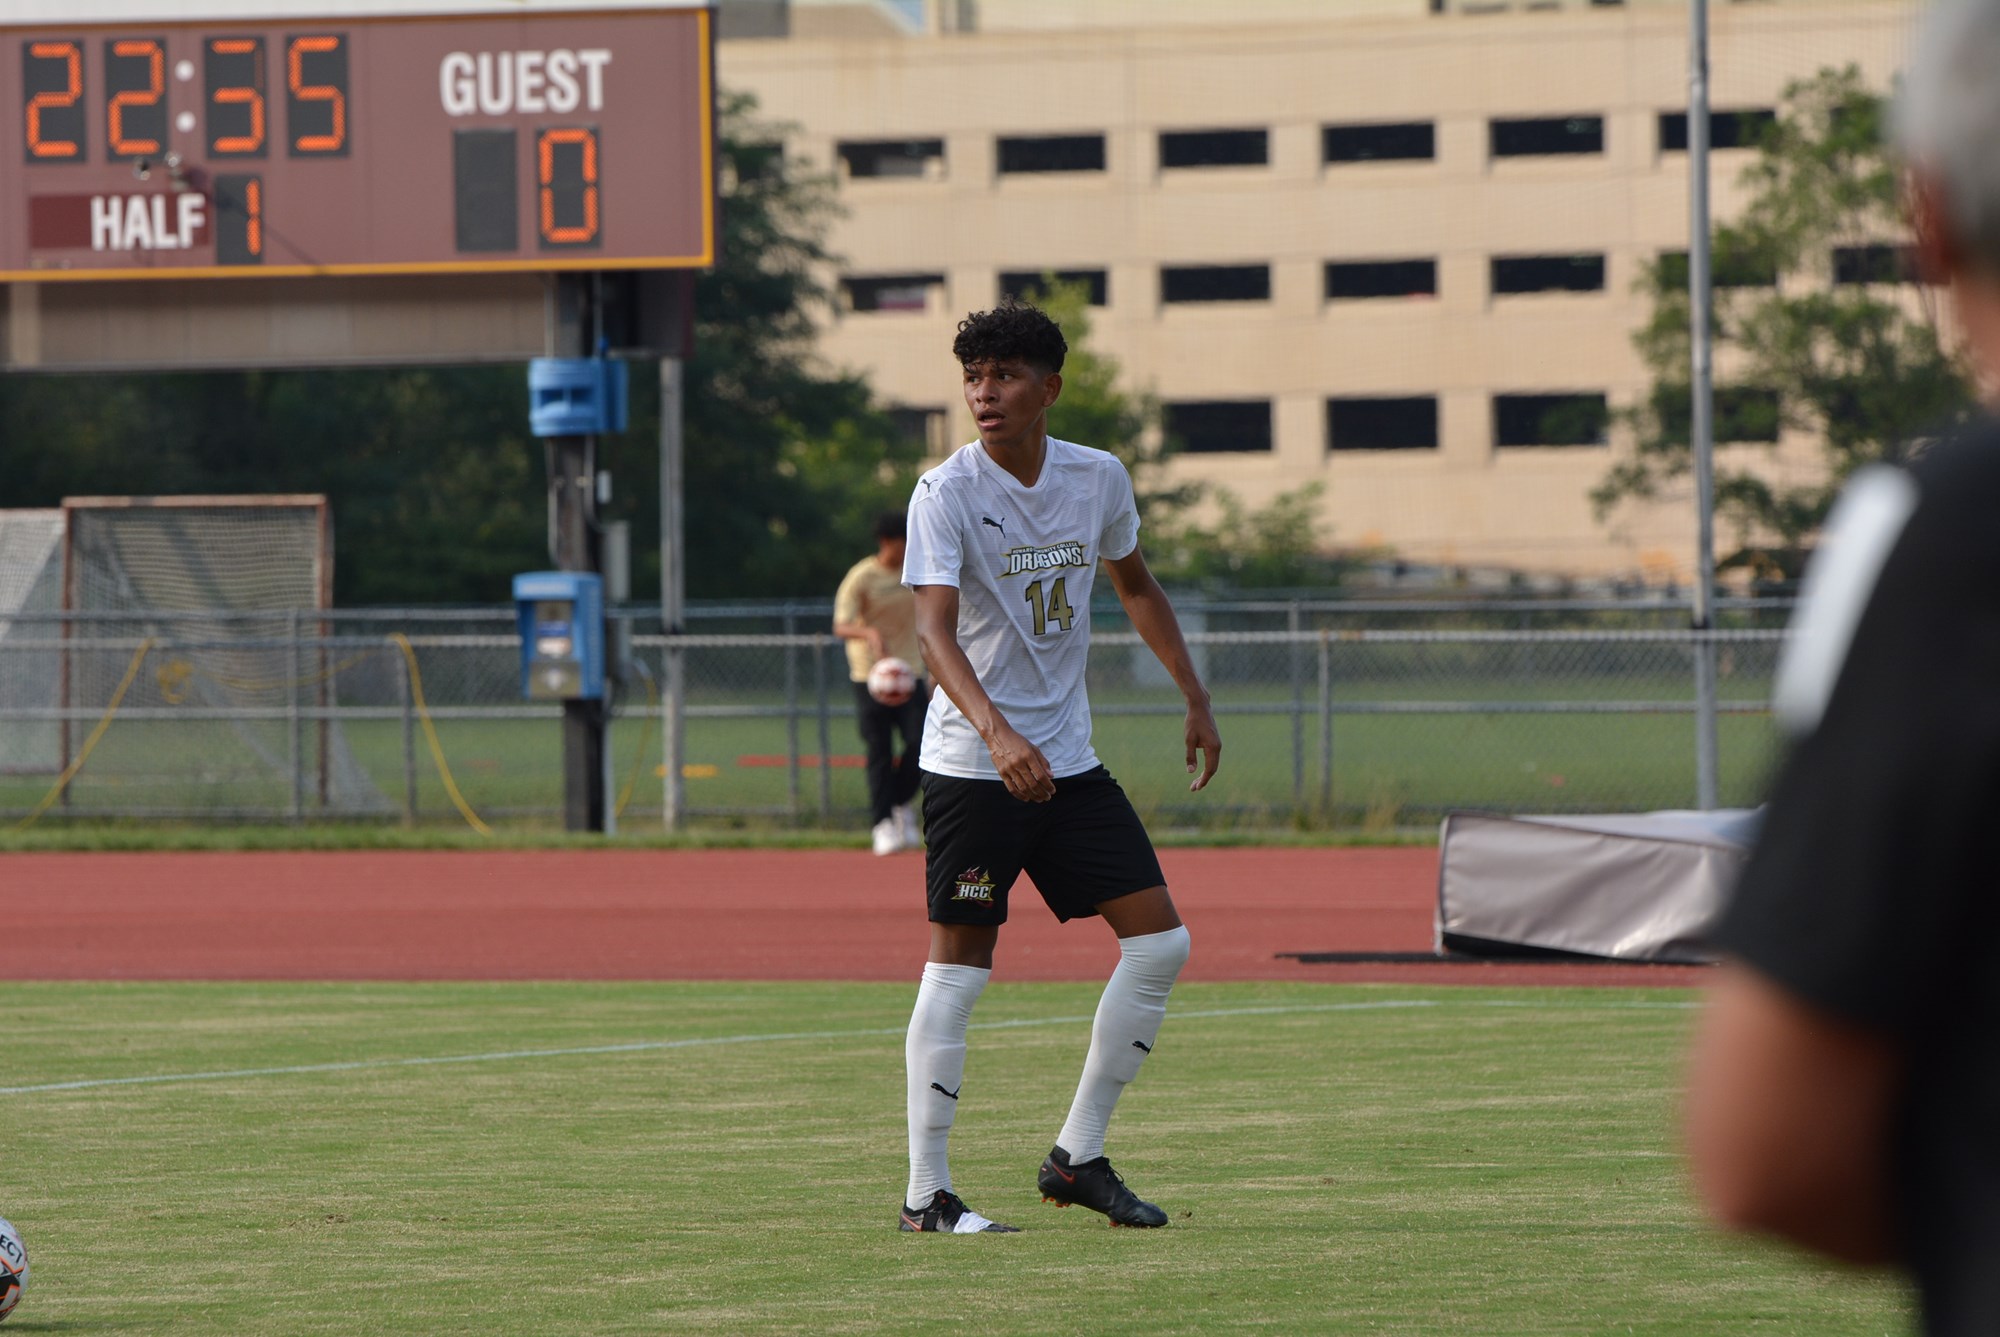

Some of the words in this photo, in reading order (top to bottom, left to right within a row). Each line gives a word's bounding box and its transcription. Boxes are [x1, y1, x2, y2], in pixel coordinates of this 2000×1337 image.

[26, 36, 346, 158] 22:35
[440, 49, 611, 116] GUEST
[90, 193, 206, 251] HALF
[245, 179, 262, 256] 1
[538, 128, 598, 244] 0
[1009, 547, 1082, 574] DRAGONS
[1025, 577, 1074, 636] 14
[959, 884, 989, 899] HCC
